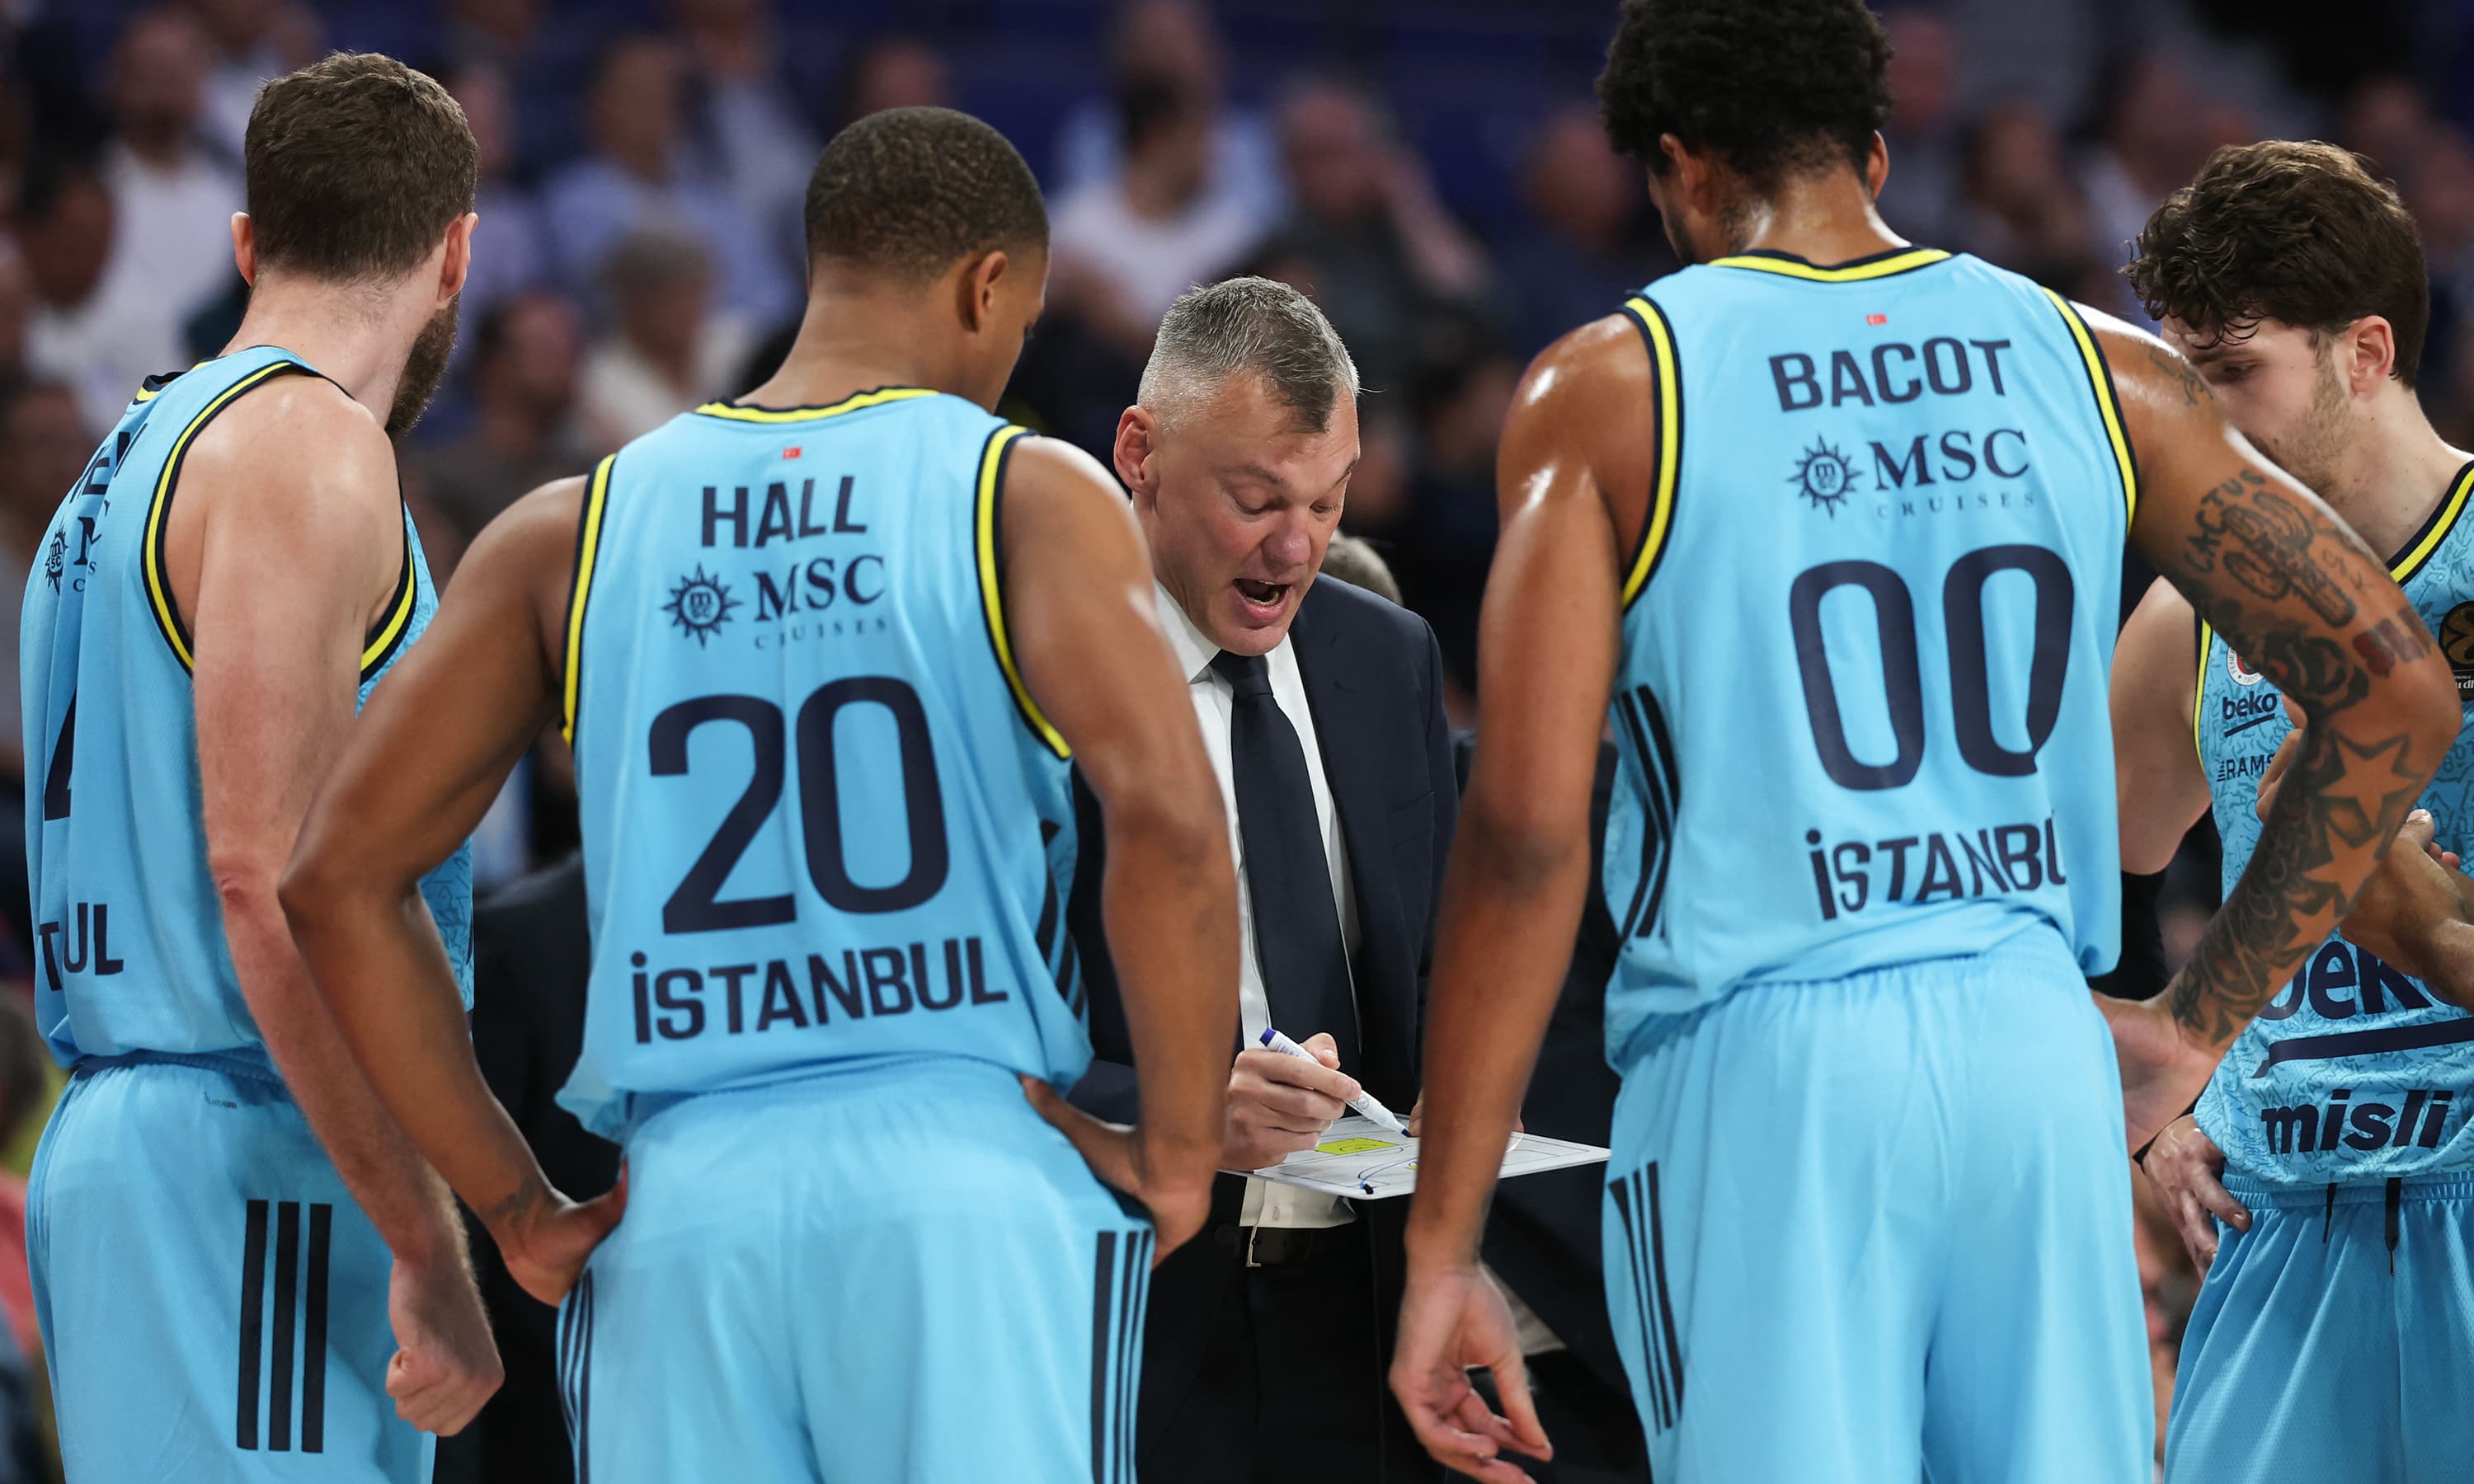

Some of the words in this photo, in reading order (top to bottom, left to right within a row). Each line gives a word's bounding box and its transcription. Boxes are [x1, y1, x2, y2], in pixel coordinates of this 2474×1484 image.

[1769, 337, 2011, 412] BACOT
[1868, 429, 2029, 491] MSC
[701, 476, 867, 547] HALL
[1876, 491, 2034, 519] CRUISES
[753, 554, 885, 622] MSC
[1789, 544, 2075, 791] 00
[2222, 691, 2278, 720] beko
[647, 674, 950, 935] 20
[630, 937, 1009, 1044] İSTANBUL
[2257, 940, 2462, 1021] ek
[2260, 1088, 2454, 1155] misli
